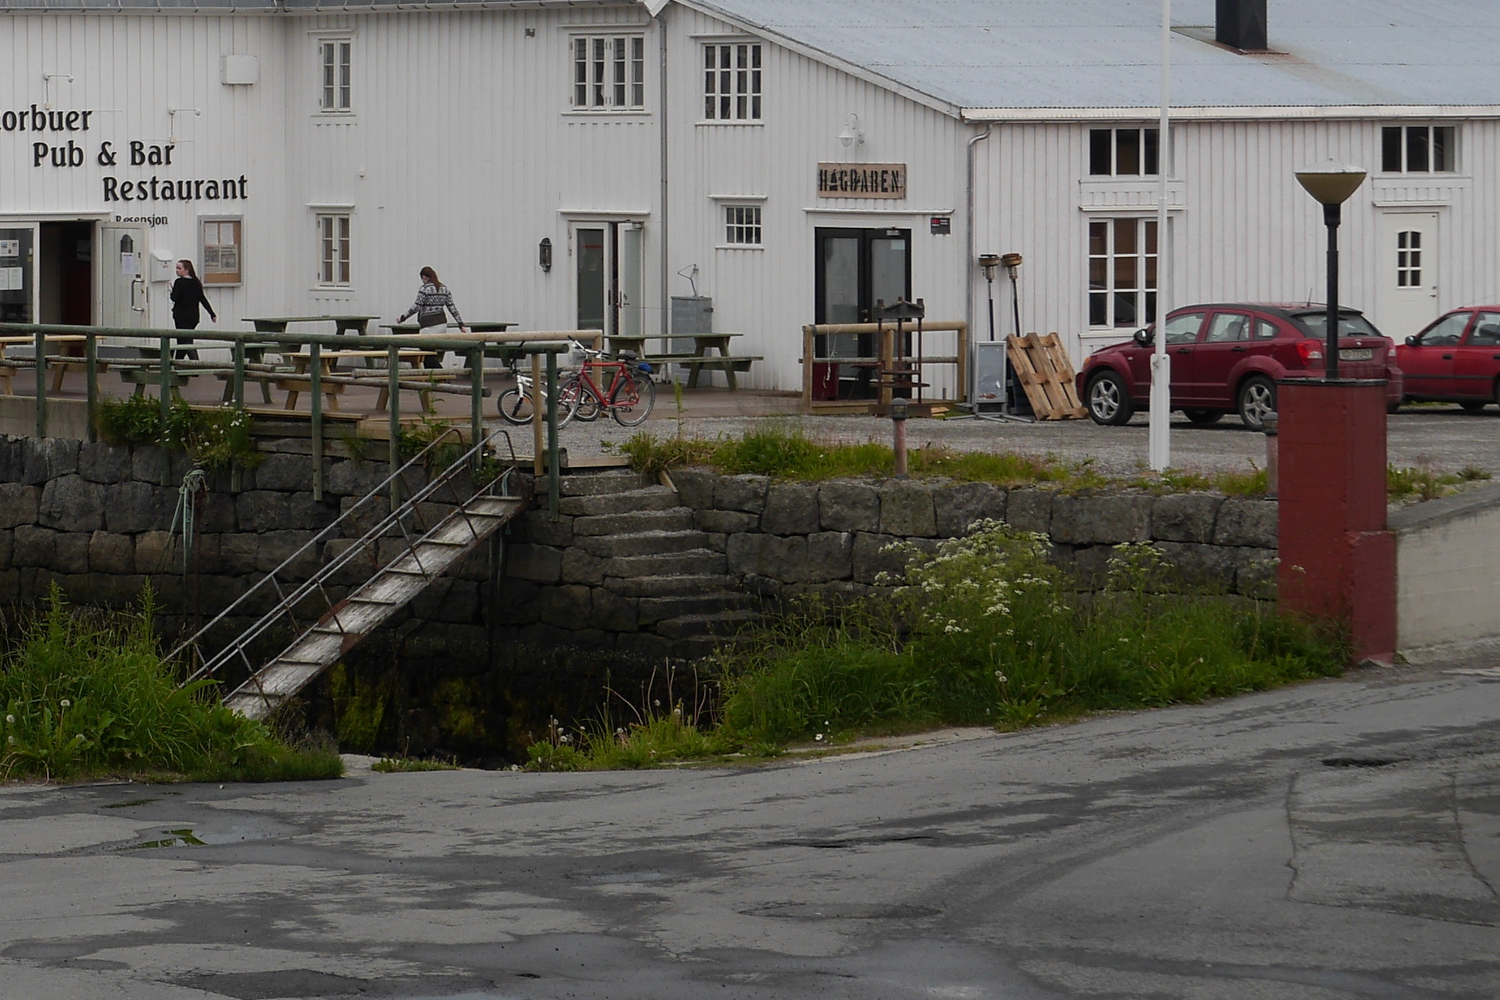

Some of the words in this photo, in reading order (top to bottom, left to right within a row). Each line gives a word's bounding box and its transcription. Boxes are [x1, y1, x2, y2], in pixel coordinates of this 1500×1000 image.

[32, 140, 84, 167] Pub
[97, 141, 117, 166] &
[129, 140, 175, 166] Bar
[102, 174, 248, 202] Restaurant
